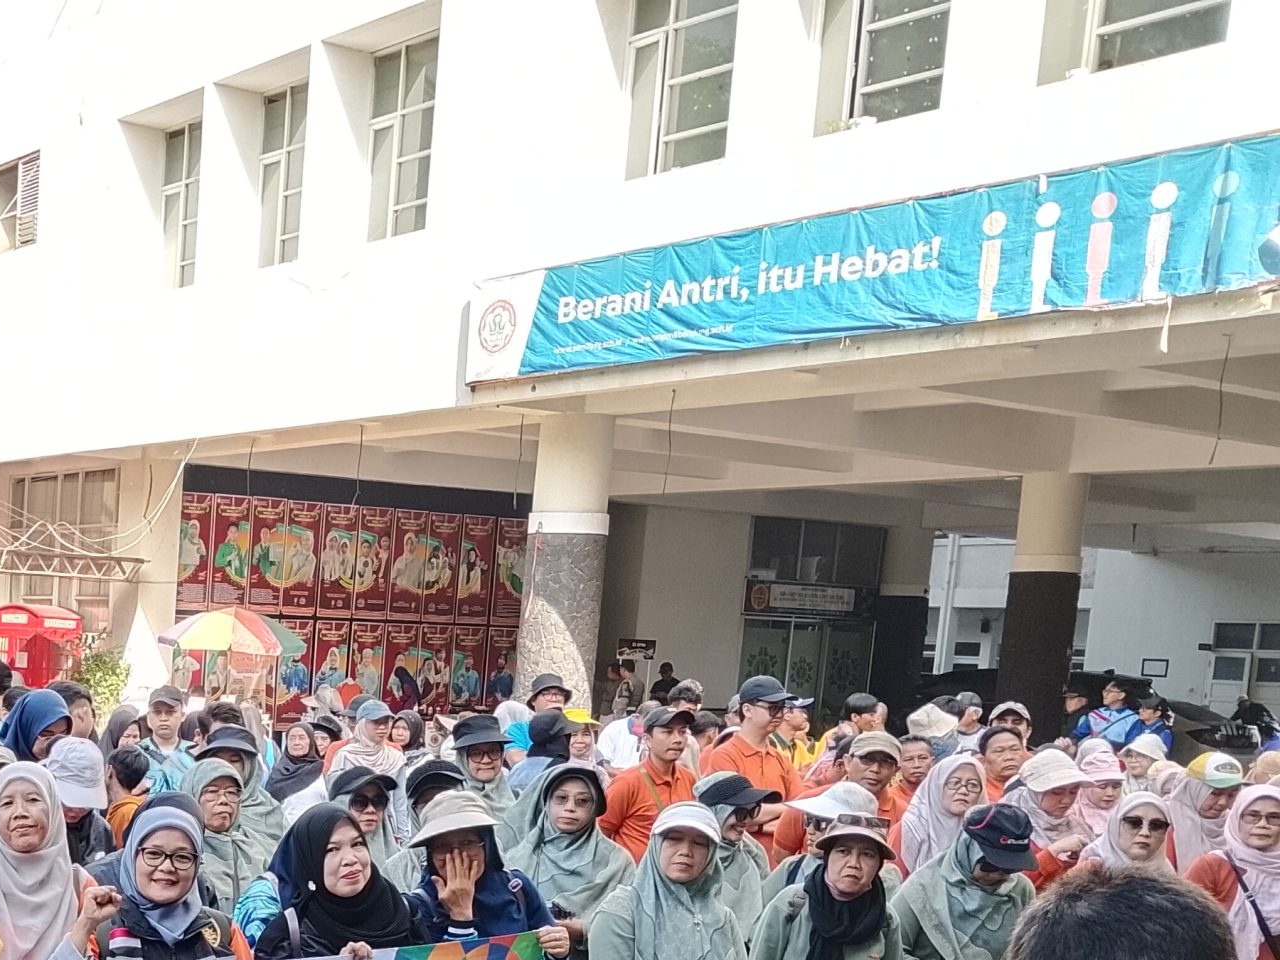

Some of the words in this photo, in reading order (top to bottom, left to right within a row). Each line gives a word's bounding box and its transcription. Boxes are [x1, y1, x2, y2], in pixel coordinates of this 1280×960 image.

[556, 280, 653, 324] Berani
[657, 265, 750, 309] Antri,
[756, 261, 805, 295] itu
[812, 234, 942, 286] Hebat!
